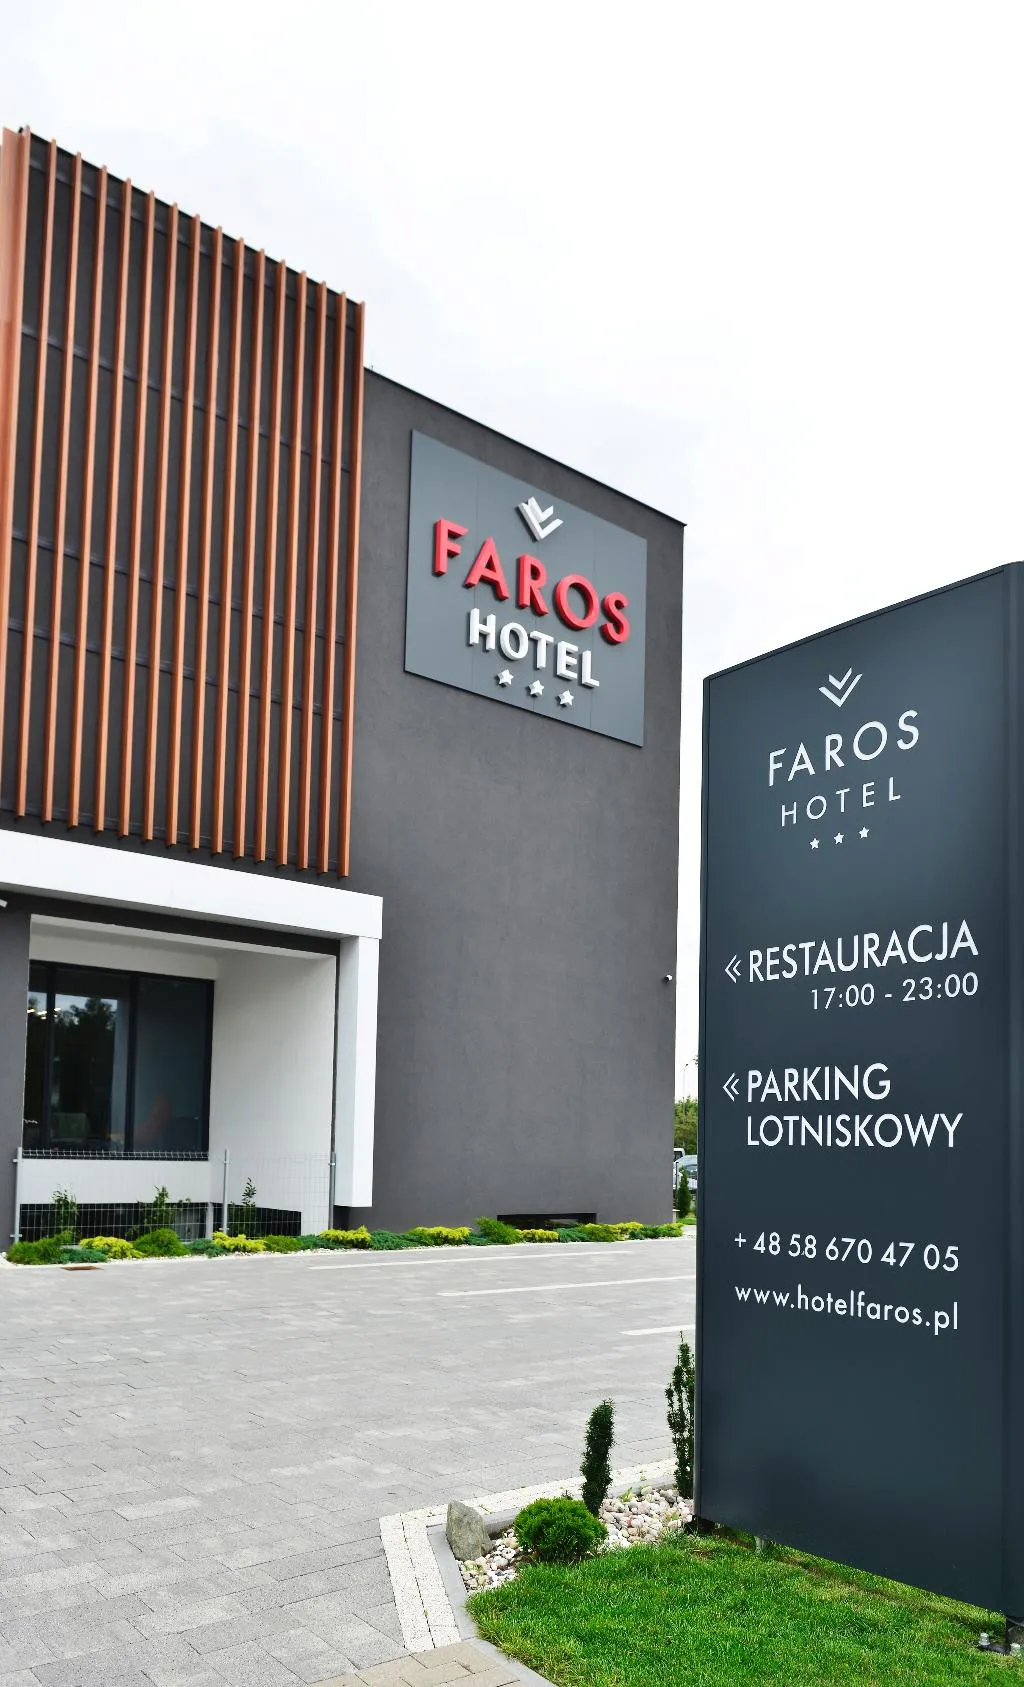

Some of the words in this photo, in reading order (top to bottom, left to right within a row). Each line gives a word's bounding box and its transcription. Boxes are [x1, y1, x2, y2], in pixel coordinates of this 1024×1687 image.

[433, 516, 630, 644] FAROS
[468, 607, 600, 688] HOTEL
[768, 709, 920, 787] FAROS
[781, 776, 901, 827] HOTEL
[749, 919, 979, 983] RESTAURACJA
[811, 983, 875, 1010] 17:00
[901, 971, 979, 1002] 23:00
[747, 1062, 892, 1103] PARKING
[747, 1112, 964, 1148] LOTNISKOWY
[753, 1231, 781, 1256] 48
[788, 1233, 817, 1259] 58
[825, 1236, 873, 1264] 670
[880, 1241, 915, 1268] 47
[923, 1243, 960, 1272] 05
[734, 1283, 959, 1336] www.hotelfaros.pl
